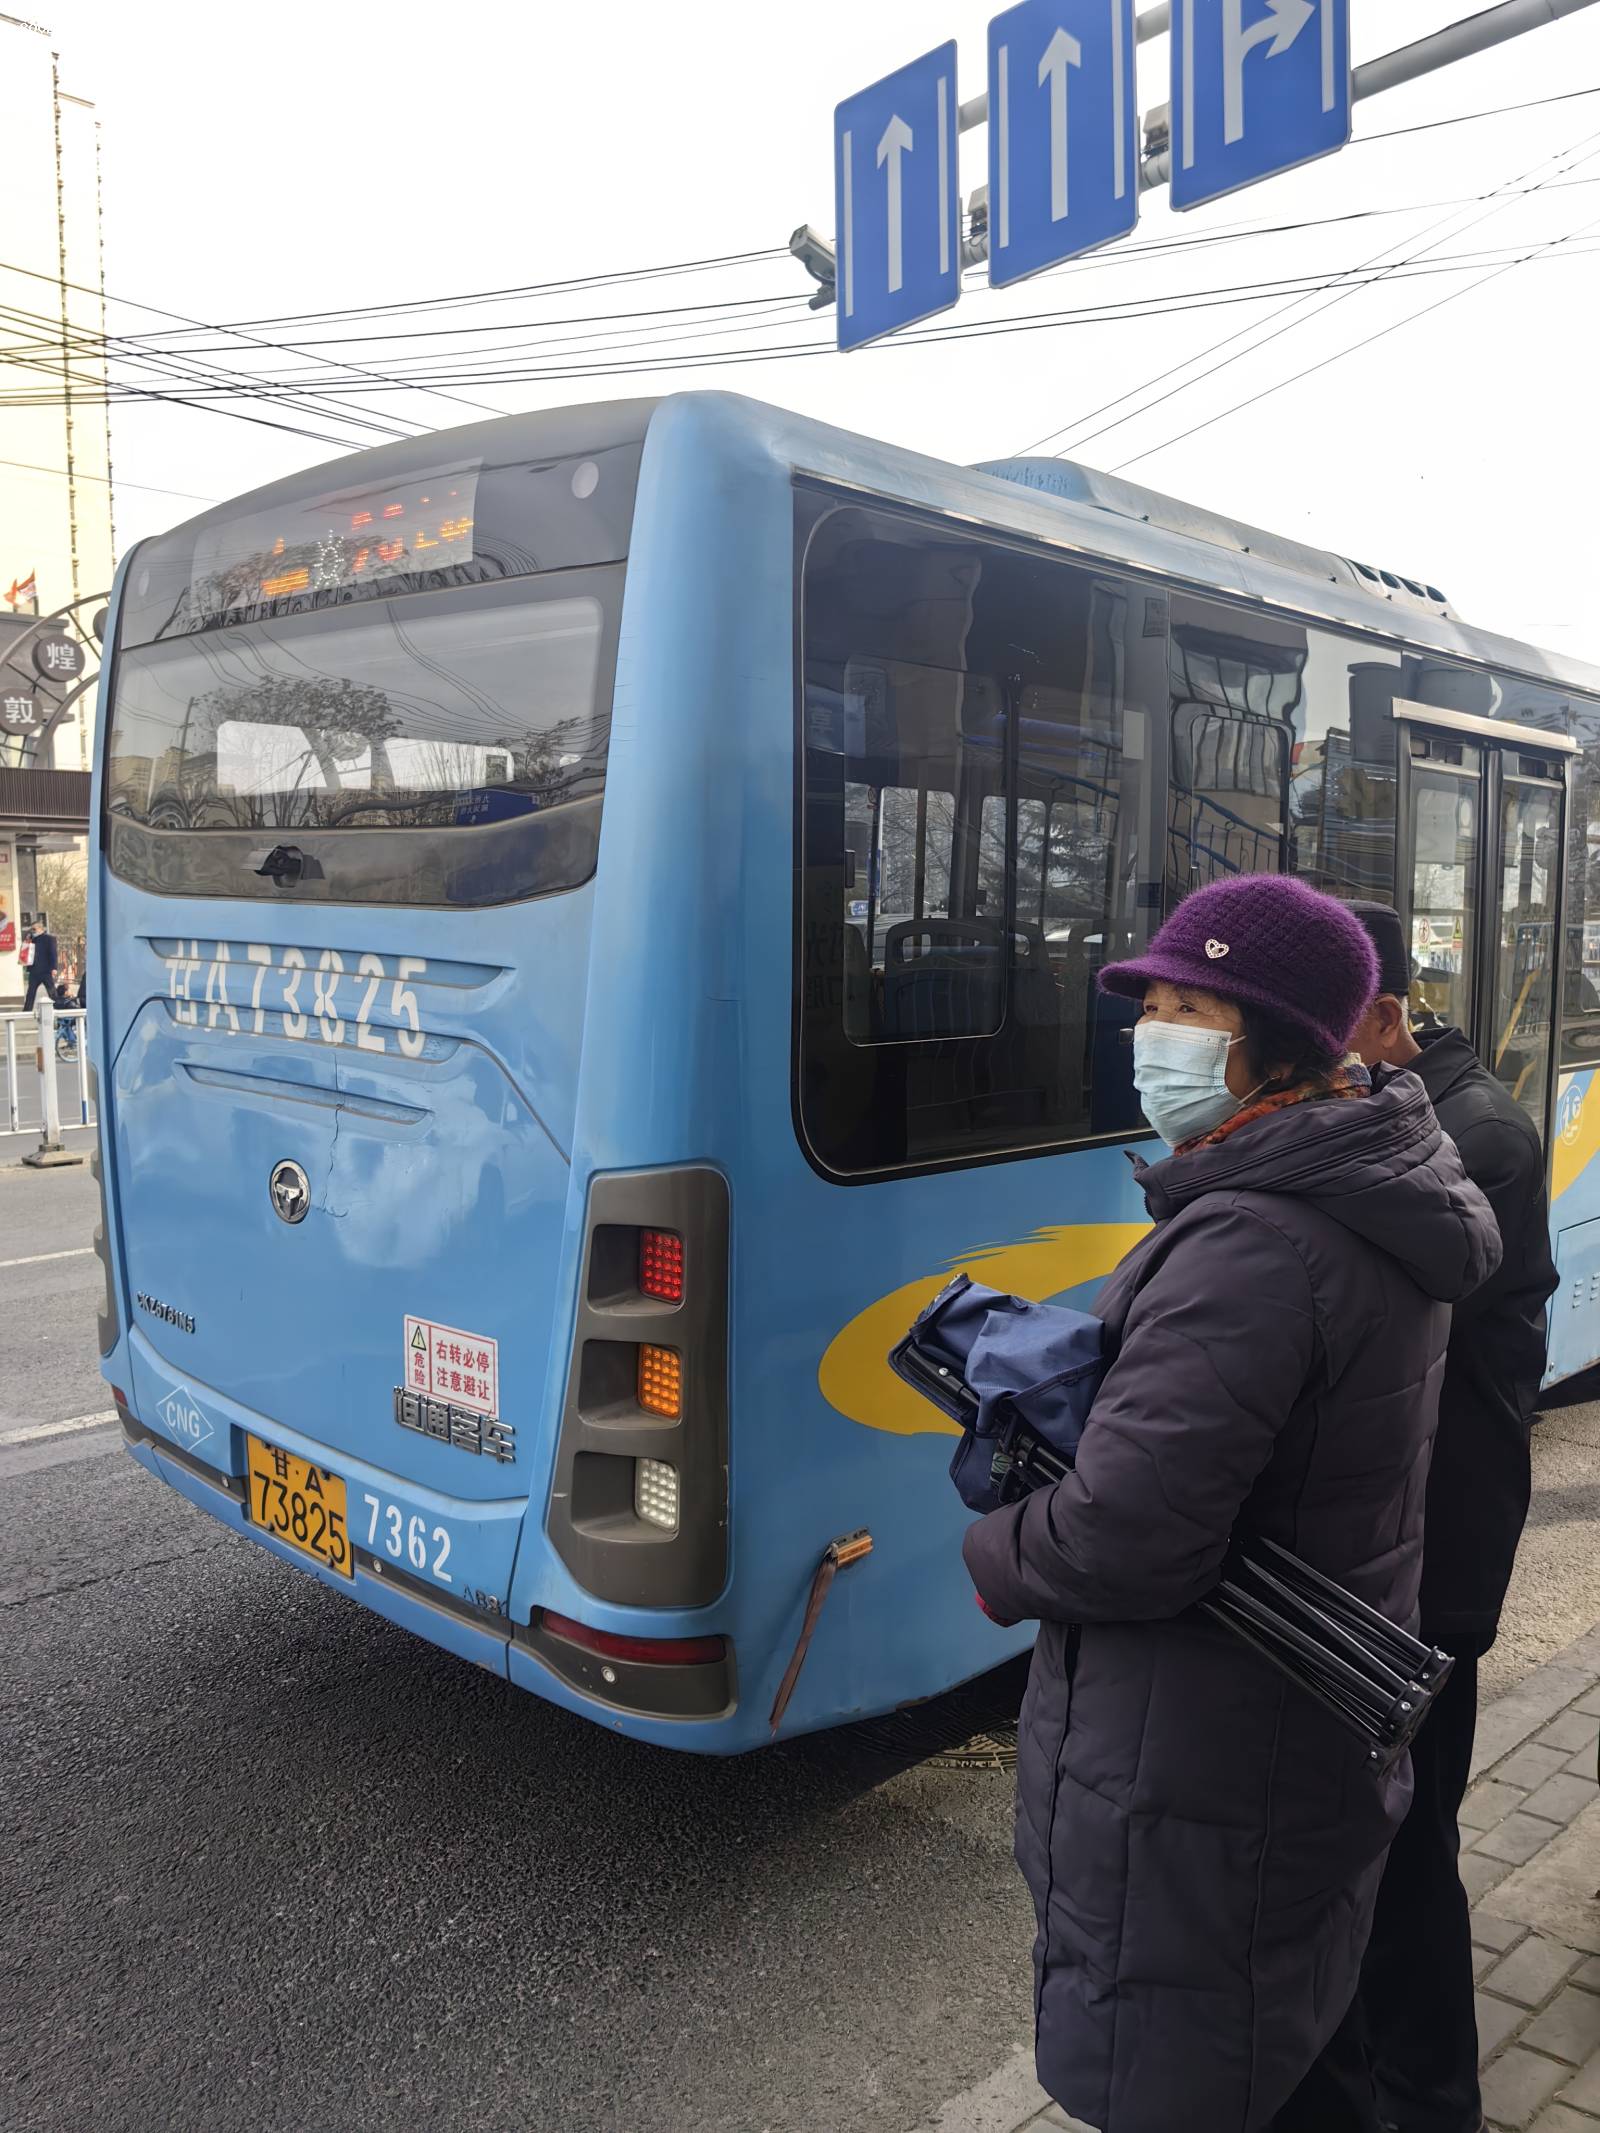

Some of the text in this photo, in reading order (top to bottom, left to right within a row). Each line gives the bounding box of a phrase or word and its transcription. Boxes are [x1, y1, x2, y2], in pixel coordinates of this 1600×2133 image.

[414, 1351, 426, 1386] 危险
[436, 1339, 490, 1374] 右转必停
[436, 1366, 491, 1401] 注意避让
[165, 1404, 201, 1439] CNG
[394, 1385, 516, 1464] 恒通客车
[253, 1470, 346, 1565] 73825
[363, 1493, 453, 1583] 7362
